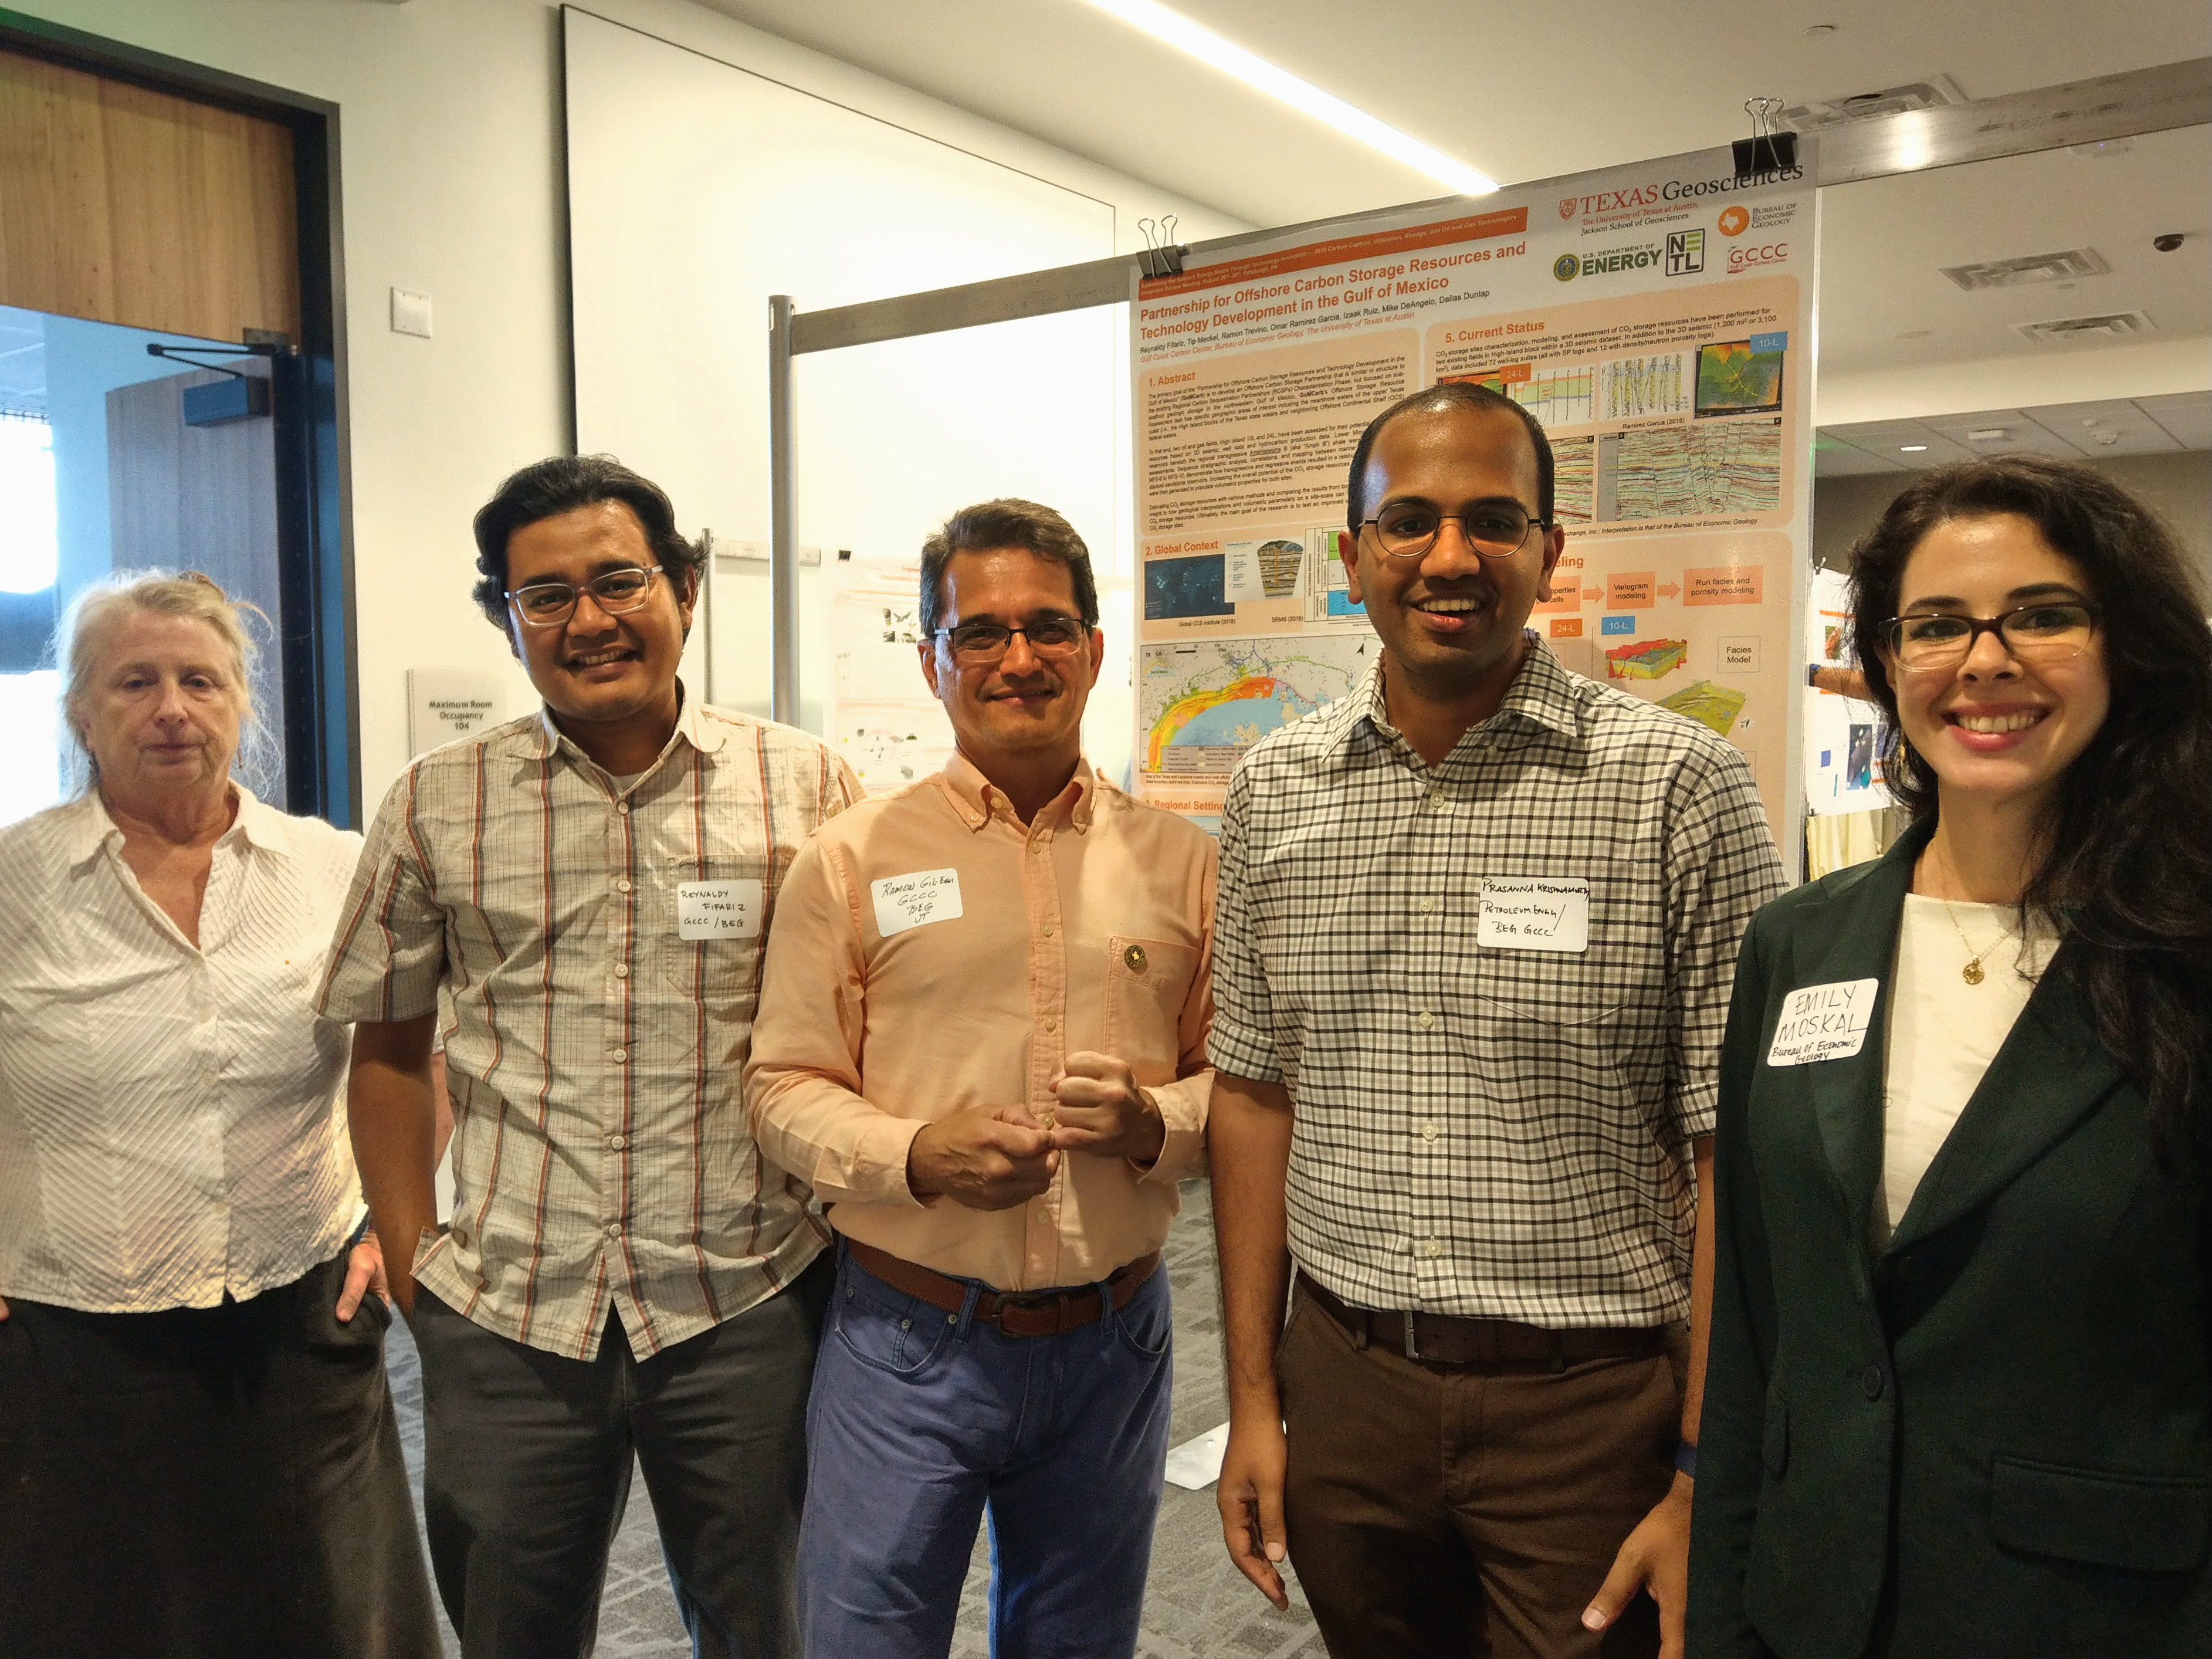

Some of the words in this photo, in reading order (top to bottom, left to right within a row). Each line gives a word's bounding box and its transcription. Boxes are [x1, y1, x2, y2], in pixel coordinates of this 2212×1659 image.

[1580, 184, 1658, 215] TEXAS
[1596, 212, 1631, 223] University
[1673, 201, 1696, 211] Austin
[1752, 210, 1796, 222] ECONOMIC
[1753, 205, 1783, 215] BUREAU
[1581, 226, 1607, 236] Jackson
[1610, 219, 1633, 230] School
[1644, 214, 1688, 225] Geosciences
[1752, 218, 1790, 228] GEOLOGY
[1598, 245, 1644, 256] DEPARTMENT
[1730, 243, 1787, 263] GCCC
[1582, 248, 1663, 276] ENERGY
[1141, 298, 1210, 320] Partnership
[1213, 295, 1231, 307] for
[1235, 285, 1289, 303] Offshore
[1295, 276, 1343, 292] Carbon
[1349, 265, 1404, 282] Storage
[1410, 250, 1490, 272] Resources
[1496, 242, 1525, 258] and
[1140, 319, 1208, 338] Technology
[1213, 300, 1296, 326] Development
[1301, 299, 1312, 311] in
[1317, 294, 1339, 308] the
[1343, 287, 1373, 303] Gulf
[1377, 284, 1391, 297] of
[1396, 277, 1448, 294] Mexico
[1140, 343, 1165, 353] Reynaldy
[1187, 337, 1195, 346] Tip
[1197, 333, 1220, 343] Meckel,
[1290, 318, 1316, 327] Ramirez
[1317, 313, 1341, 322] Garcia,
[1343, 309, 1361, 318] Izaak
[1363, 306, 1379, 314] Ruiz,
[1382, 303, 1398, 312] Mike
[1401, 297, 1436, 309] DeAngelo,
[1439, 294, 1461, 303] Dallas
[1464, 290, 1489, 299] Dunlap
[1484, 339, 1529, 350] characterization,
[1574, 327, 1608, 337] assessment
[1658, 319, 1688, 327] resources
[1726, 308, 1759, 320] performed
[1445, 333, 1454, 343] 5.
[1458, 324, 1502, 341] Current
[1506, 320, 1544, 334] Status
[1149, 378, 1155, 387] 1.
[1158, 371, 1195, 385] Abstract
[1506, 370, 1523, 378] 24-L
[1146, 546, 1152, 556] 2.
[1155, 543, 1181, 554] Global
[1184, 539, 1218, 552] Context
[1556, 556, 1584, 568] eling
[1691, 587, 1719, 597] porosity
[1557, 624, 1575, 632] 24-L
[1610, 622, 1627, 630] 10-L
[1727, 655, 1750, 663] Model
[429, 700, 469, 709] Maximum
[470, 700, 492, 709] Room
[440, 710, 483, 720] Occupancy
[1482, 878, 1534, 893] PRASANNA
[680, 890, 729, 899] REYNALDY
[897, 891, 937, 906] GCCC
[1492, 921, 1516, 935] BEG
[1524, 925, 1553, 936] GCCC
[1796, 984, 1857, 1015] EMILY
[1778, 1013, 1868, 1043] MOSKAL
[1771, 1045, 1801, 1057] Bureau
